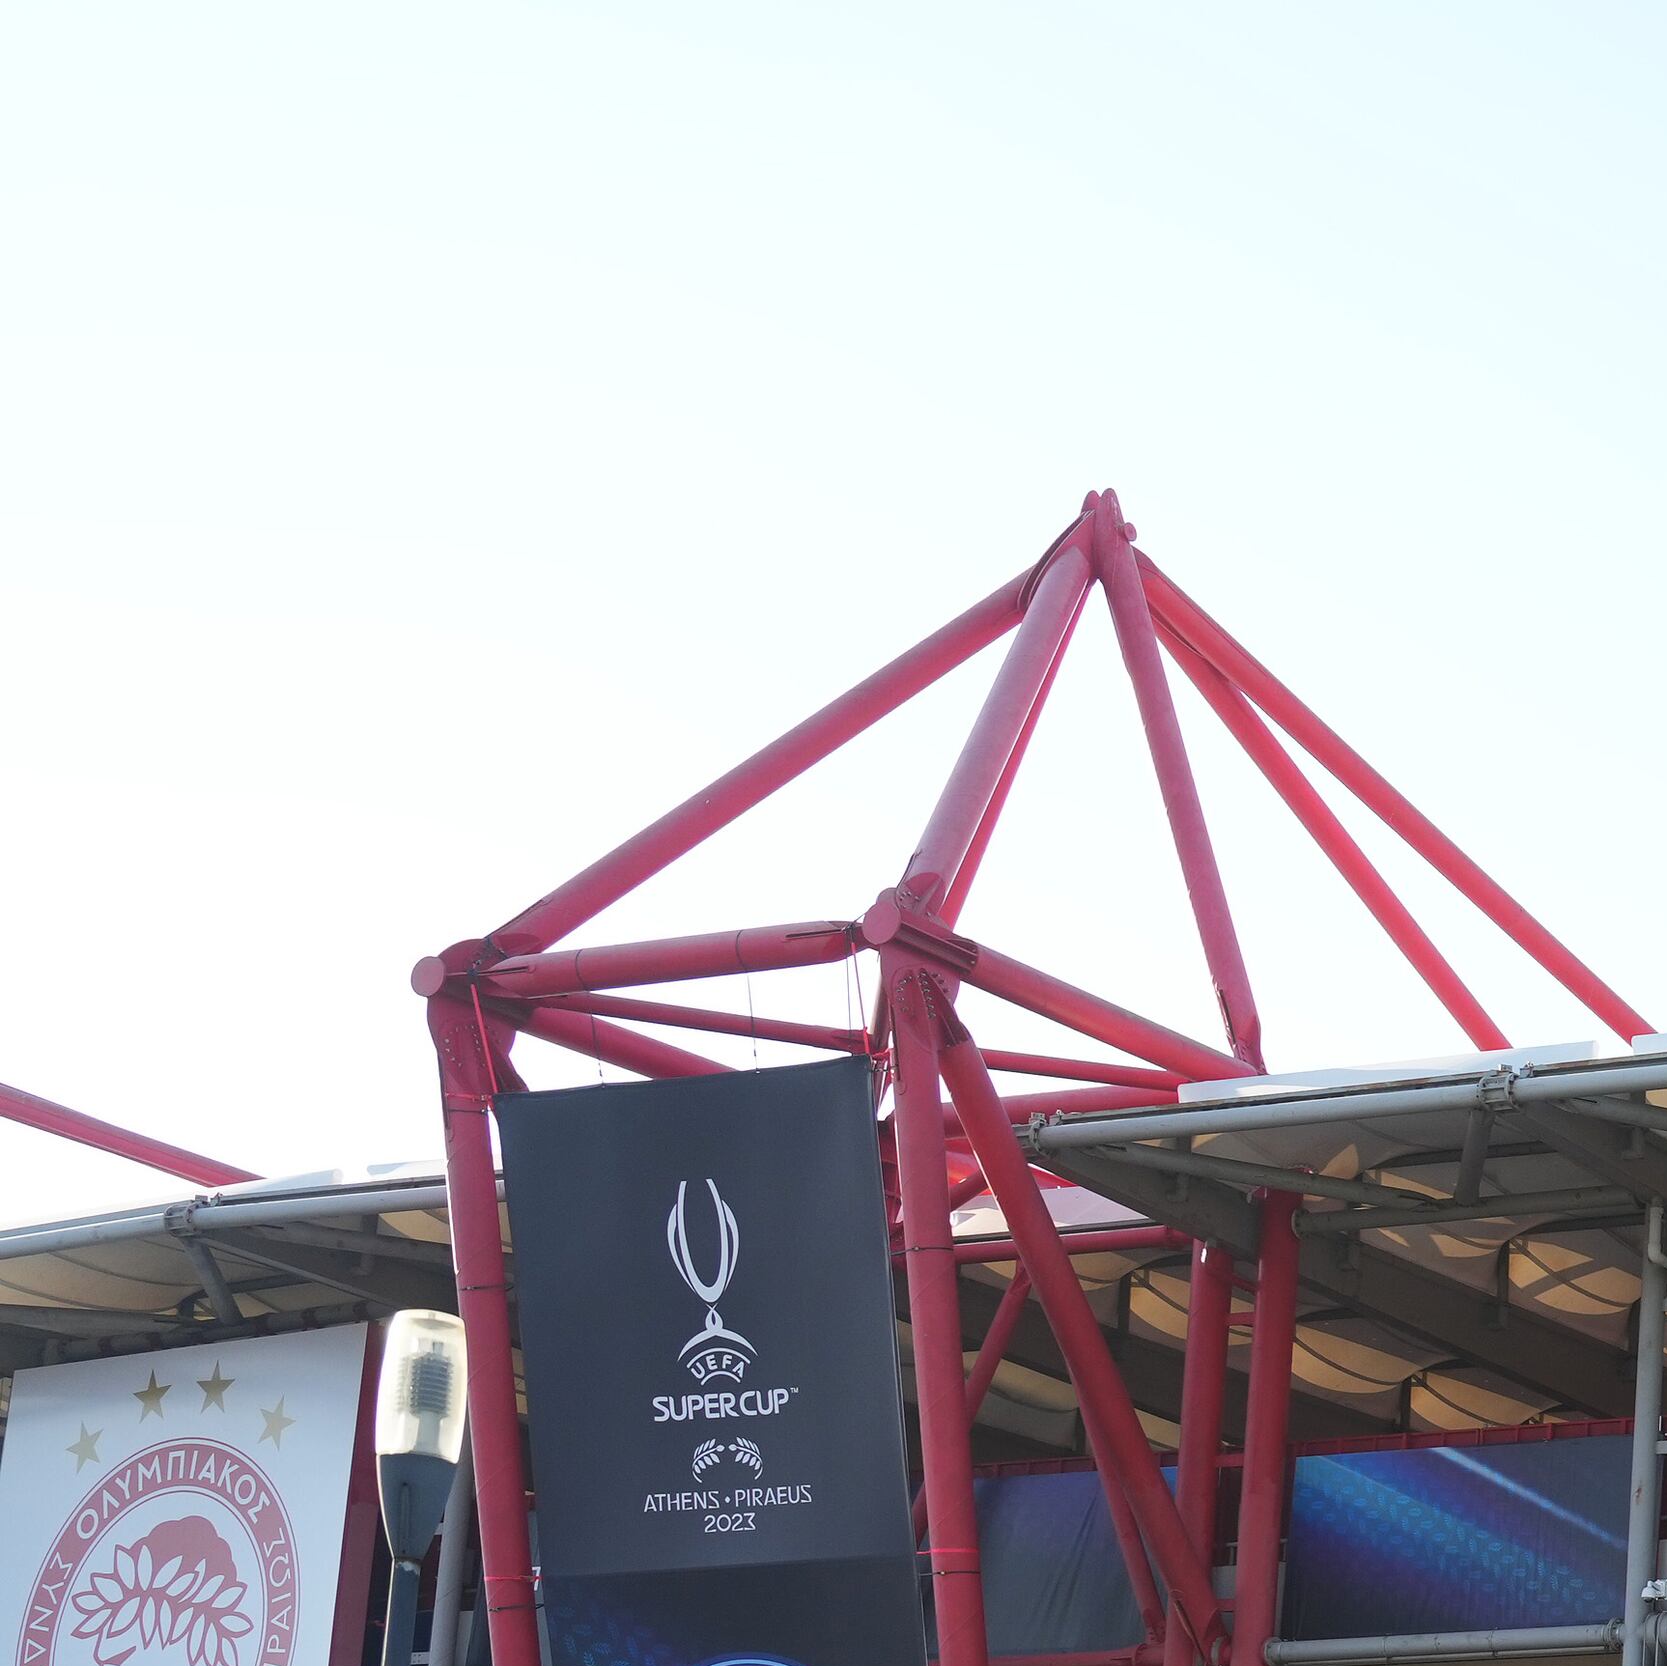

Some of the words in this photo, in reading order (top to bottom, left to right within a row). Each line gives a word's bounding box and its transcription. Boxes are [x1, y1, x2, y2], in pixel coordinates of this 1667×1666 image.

[690, 1353, 745, 1380] UEFA
[75, 1450, 275, 1541] ΟΛΥΜΠΙΑΚΟΣ
[643, 1490, 719, 1513] ATHENS
[735, 1484, 812, 1507] PIRAEUS
[704, 1513, 756, 1533] 2023
